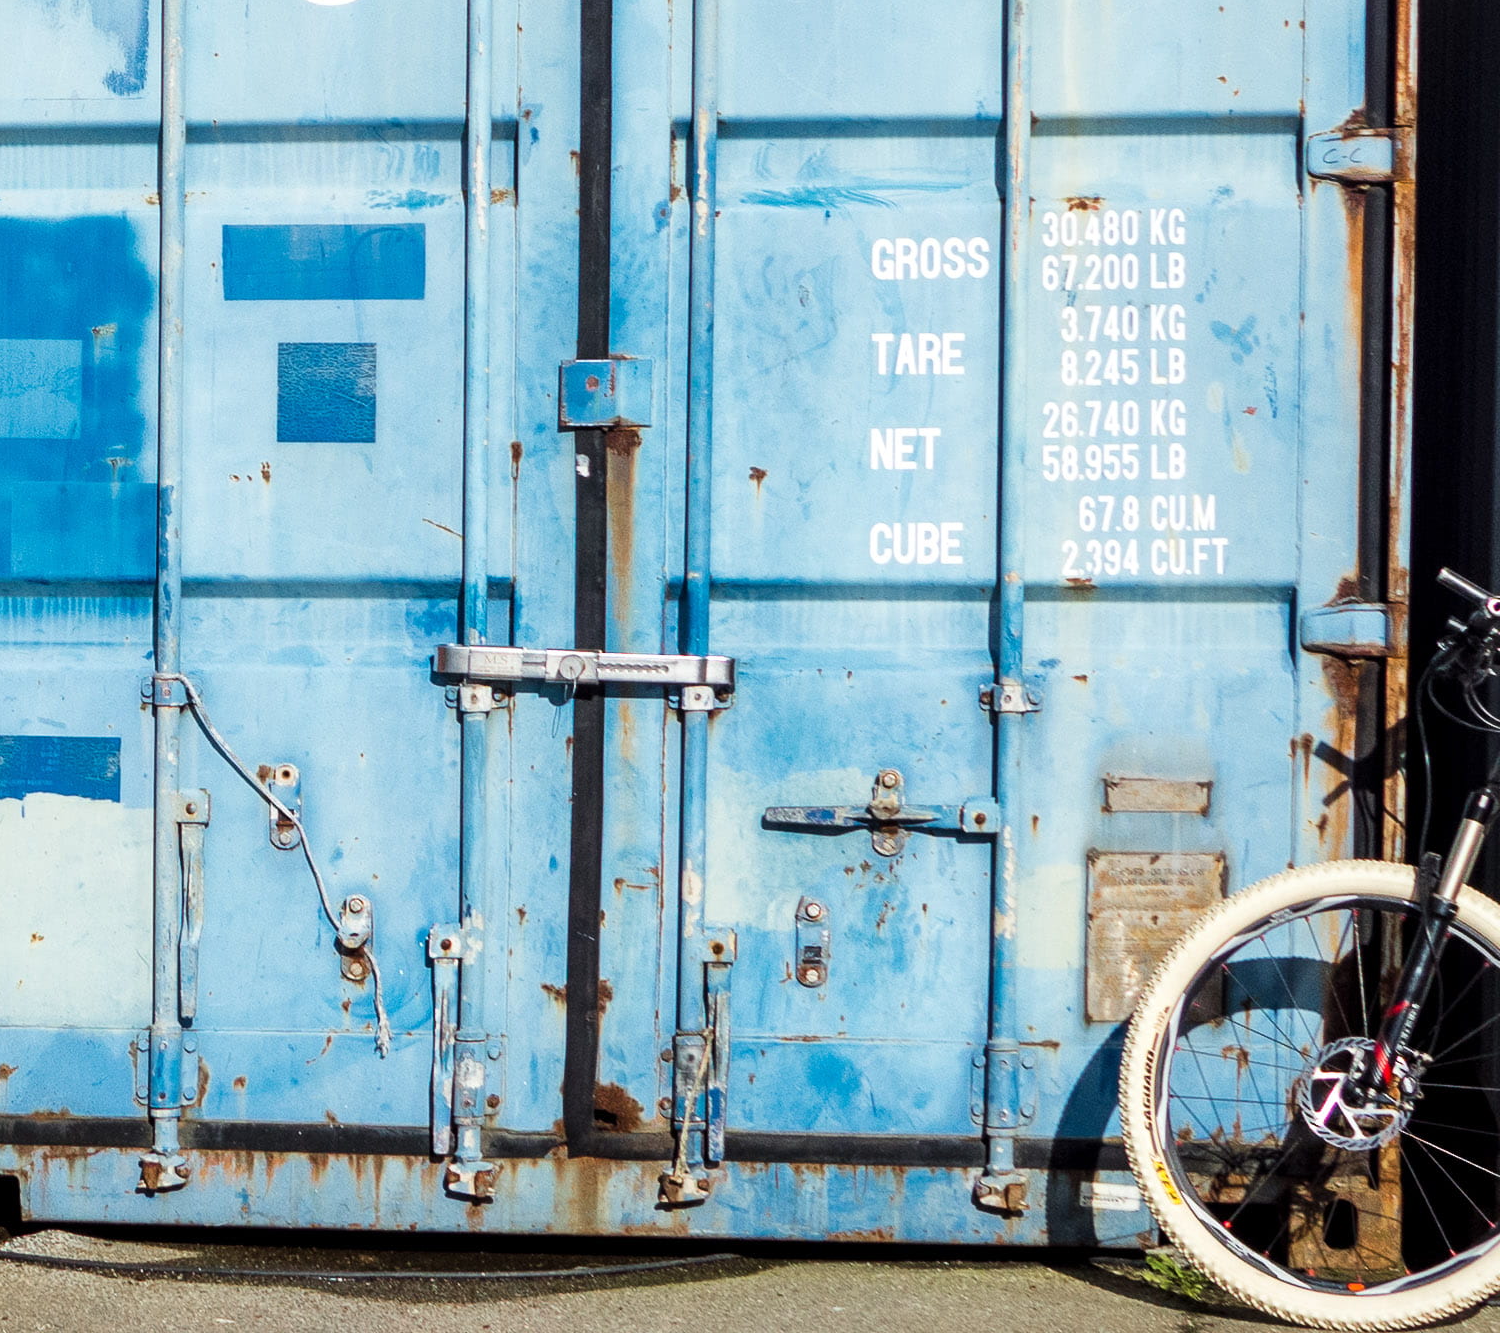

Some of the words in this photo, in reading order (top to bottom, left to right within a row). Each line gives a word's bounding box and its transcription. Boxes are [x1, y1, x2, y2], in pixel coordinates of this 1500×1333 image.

[1149, 208, 1187, 246] KG
[870, 236, 990, 281] GROSS
[1149, 251, 1186, 290] LB
[1149, 303, 1187, 341] KG
[870, 332, 966, 376] TARE
[1149, 347, 1186, 385] LB
[1150, 398, 1187, 437] KG
[870, 427, 942, 471] NET
[1150, 442, 1187, 480] LB
[1078, 494, 1140, 533] 67.8
[1149, 493, 1217, 532] CU.M
[869, 521, 964, 566] CUBE
[1149, 536, 1229, 576] CU.FT
